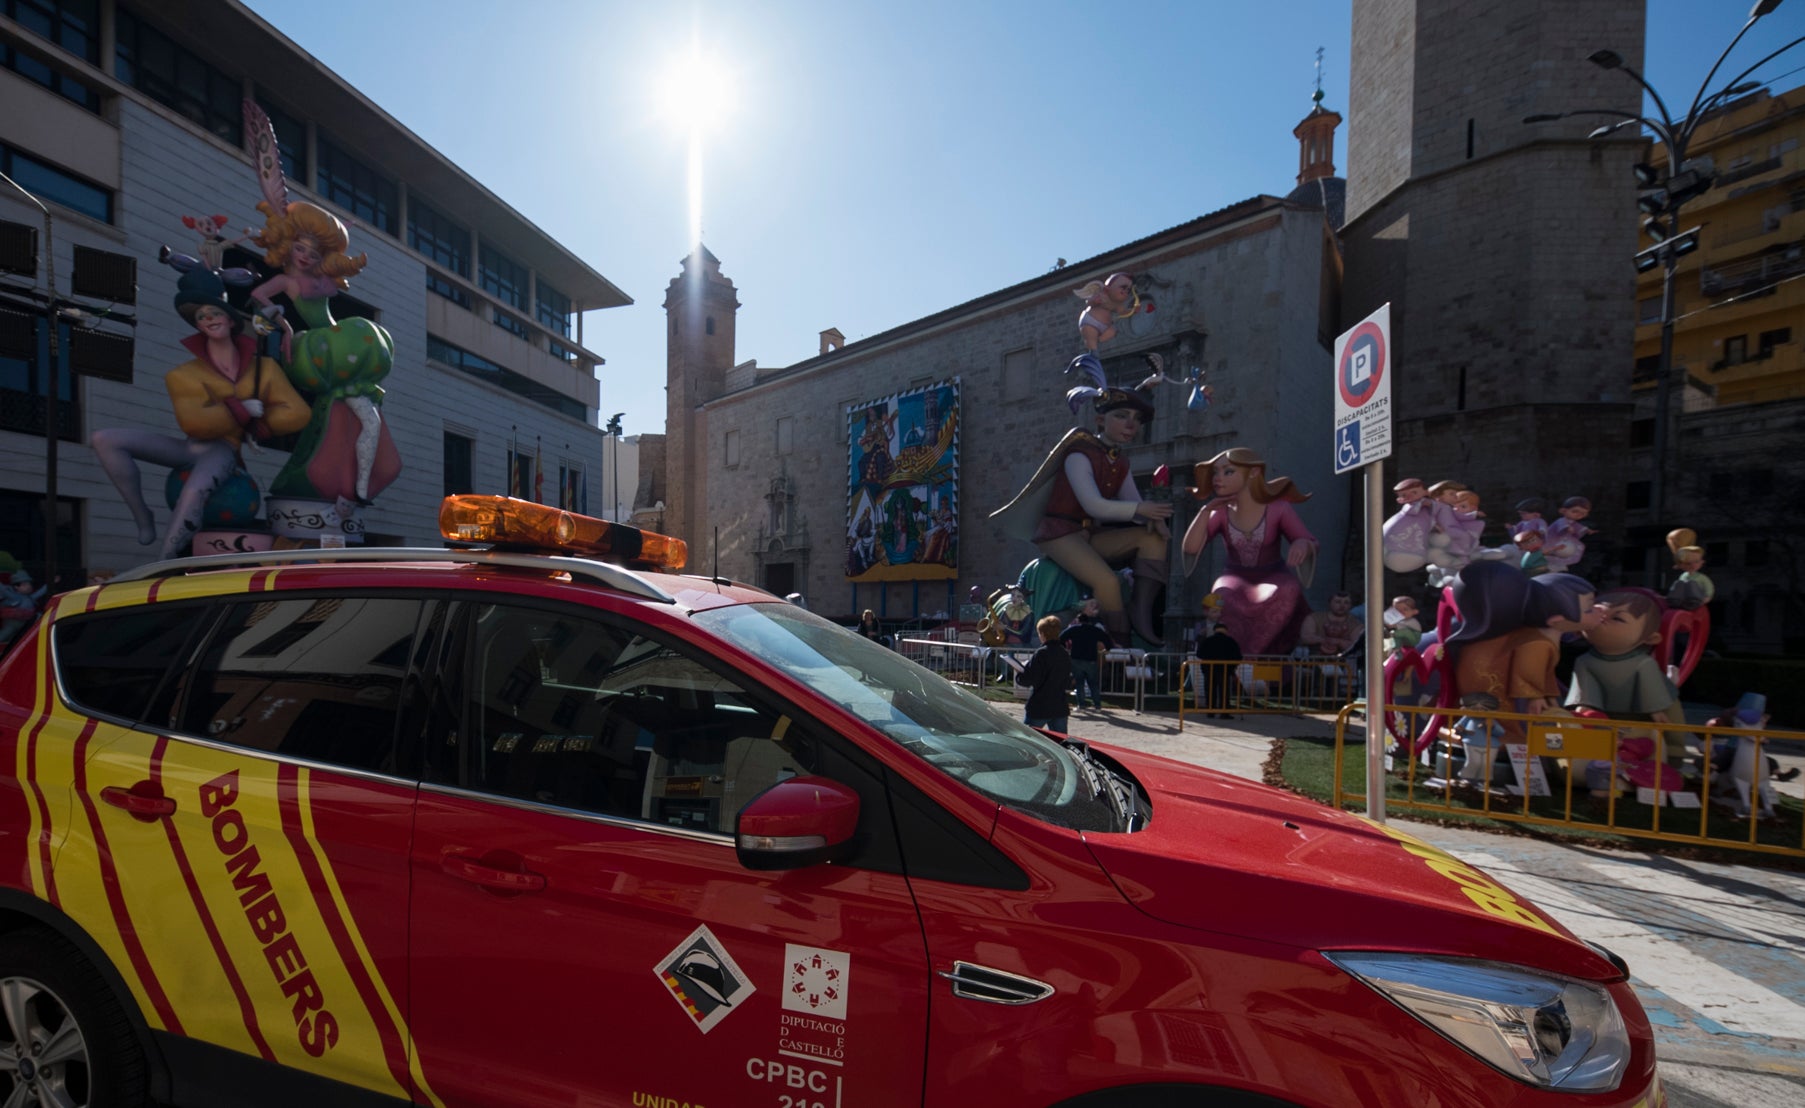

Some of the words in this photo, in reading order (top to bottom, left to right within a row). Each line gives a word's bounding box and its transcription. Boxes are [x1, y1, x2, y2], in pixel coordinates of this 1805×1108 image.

[1355, 353, 1366, 379] P
[1337, 396, 1389, 426] DISCAPACITATS
[199, 769, 339, 1058] BOMBERS
[781, 1014, 845, 1035] DIPUTACIÓ
[779, 1038, 844, 1059] CASTELLÓ
[746, 1057, 827, 1093] CPBC
